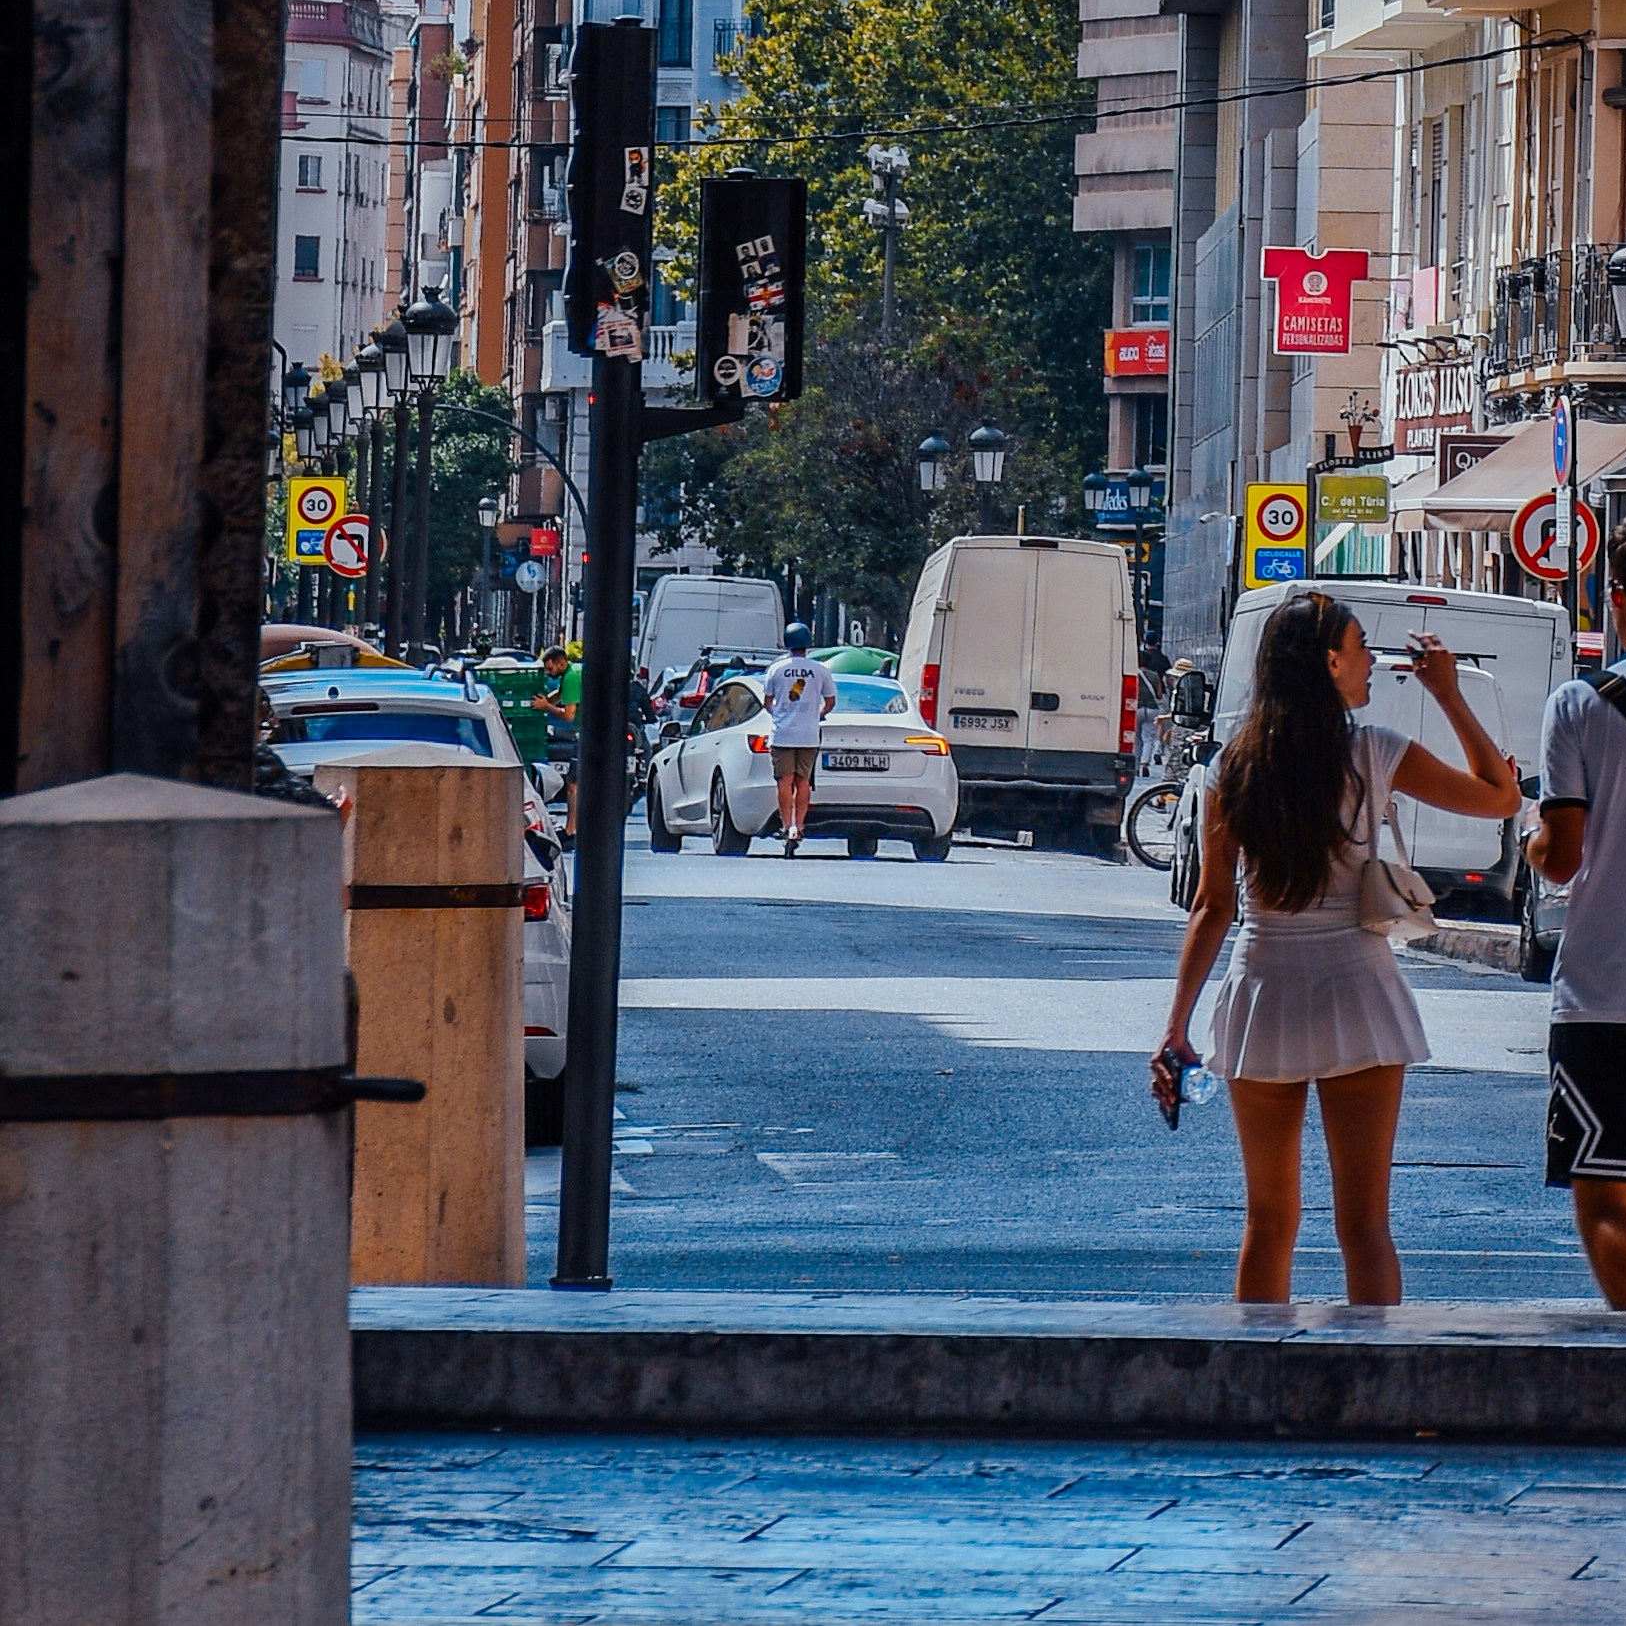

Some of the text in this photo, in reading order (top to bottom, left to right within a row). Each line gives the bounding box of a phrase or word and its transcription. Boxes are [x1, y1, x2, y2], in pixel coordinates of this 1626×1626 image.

[1282, 315, 1343, 332] CAMISETAS
[1282, 333, 1344, 346] PERSONALIZADAS
[1394, 365, 1475, 420] FLORES LLISO
[1358, 448, 1392, 460] LLISO
[306, 499, 328, 513] 30
[1340, 495, 1356, 507] del
[1268, 509, 1294, 526] 30
[1257, 550, 1302, 558] CICLOCALLE
[783, 668, 816, 679] GILDA
[954, 687, 985, 696] IVECO
[960, 716, 1010, 729] 6992 JSX
[830, 755, 887, 768] 3409 NLH
